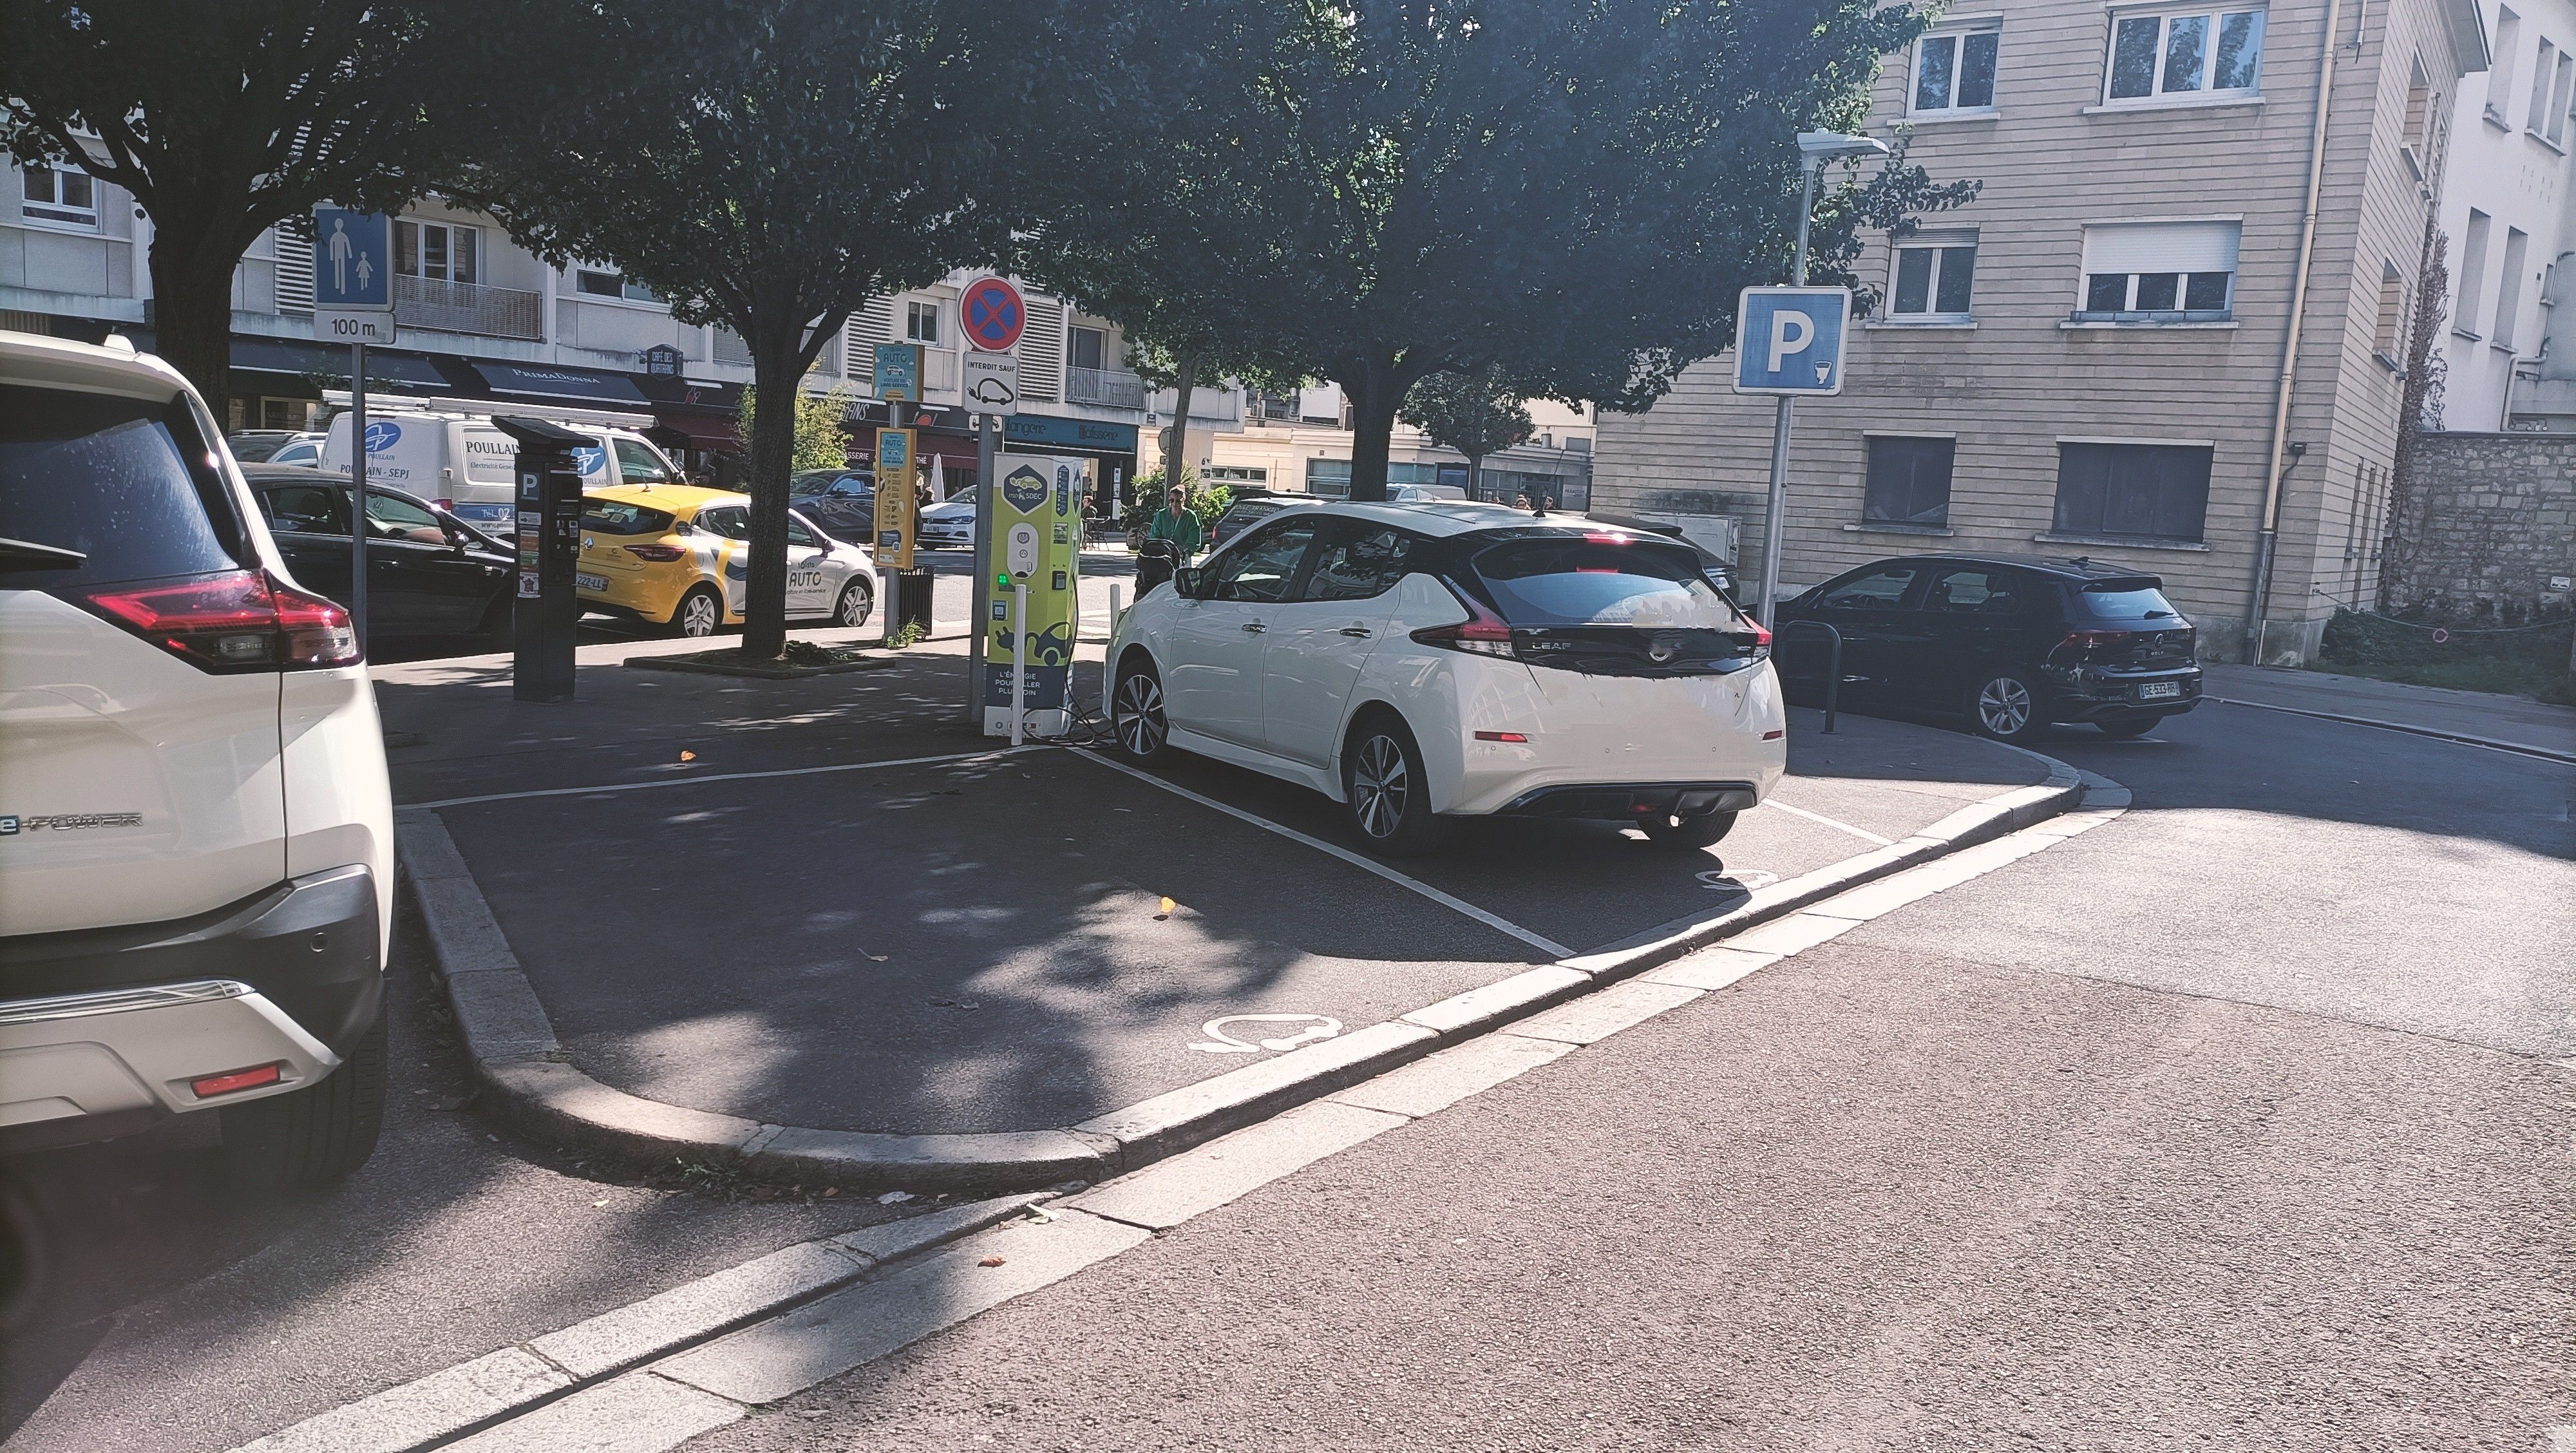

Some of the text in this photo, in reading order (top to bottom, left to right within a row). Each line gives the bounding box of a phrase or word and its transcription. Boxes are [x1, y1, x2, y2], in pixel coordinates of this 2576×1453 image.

[331, 318, 375, 336] 100 m
[1768, 310, 1815, 372] P
[883, 353, 908, 363] AUTO
[967, 361, 998, 370] INTERDIT
[843, 402, 870, 421] RANS
[523, 474, 538, 495] P
[498, 508, 511, 518] 02
[789, 571, 822, 587] AUTO
[999, 670, 1036, 679] L'ÉNGIE
